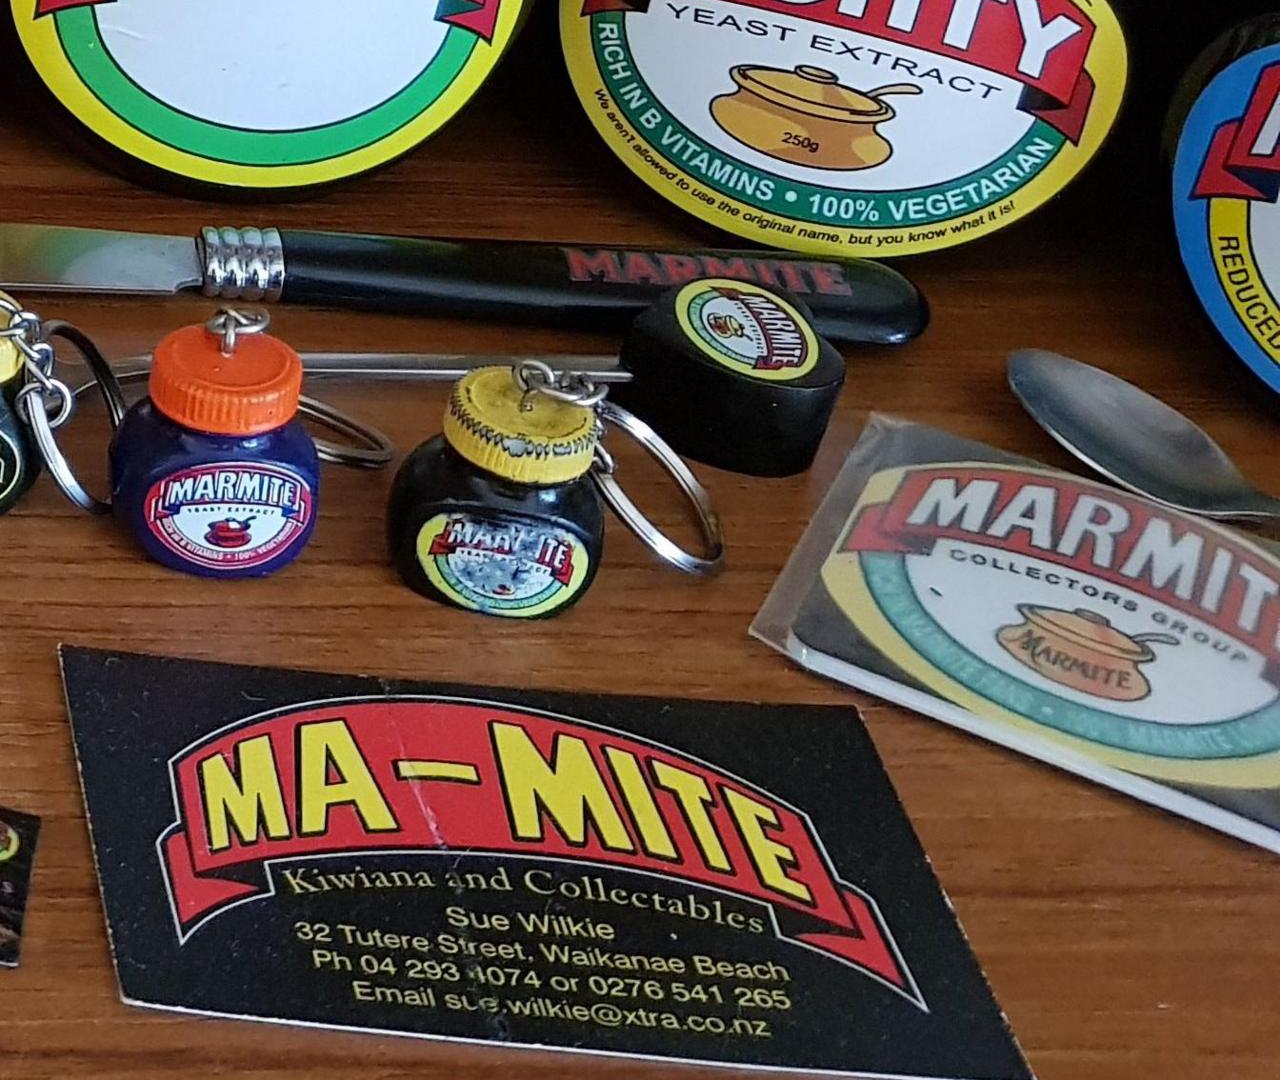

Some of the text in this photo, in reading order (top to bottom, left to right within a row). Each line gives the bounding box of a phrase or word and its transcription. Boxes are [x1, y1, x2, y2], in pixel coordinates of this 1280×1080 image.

[665, 3, 1003, 102] YEAST EXTRACT
[597, 22, 1054, 222] RICH IN B VITAMINS 100% VEGETARIAN
[781, 131, 820, 154] 250g
[595, 88, 997, 248] We allowed to use the original but you know what it
[562, 247, 854, 296] MARMITE
[739, 294, 802, 364] MARMITE
[169, 471, 297, 506] MARMITE
[949, 548, 1253, 666] COLLECTORS GROUP
[1010, 629, 1133, 690] MARMITE
[285, 866, 765, 934] Kiwiana and Collectables
[446, 906, 616, 940] Sue Wilkie
[294, 921, 792, 982] 32 Tutere Waikanae Beach
[312, 948, 792, 1010] Ph 04 293 or 0276 541 265
[351, 980, 437, 1008] Email
